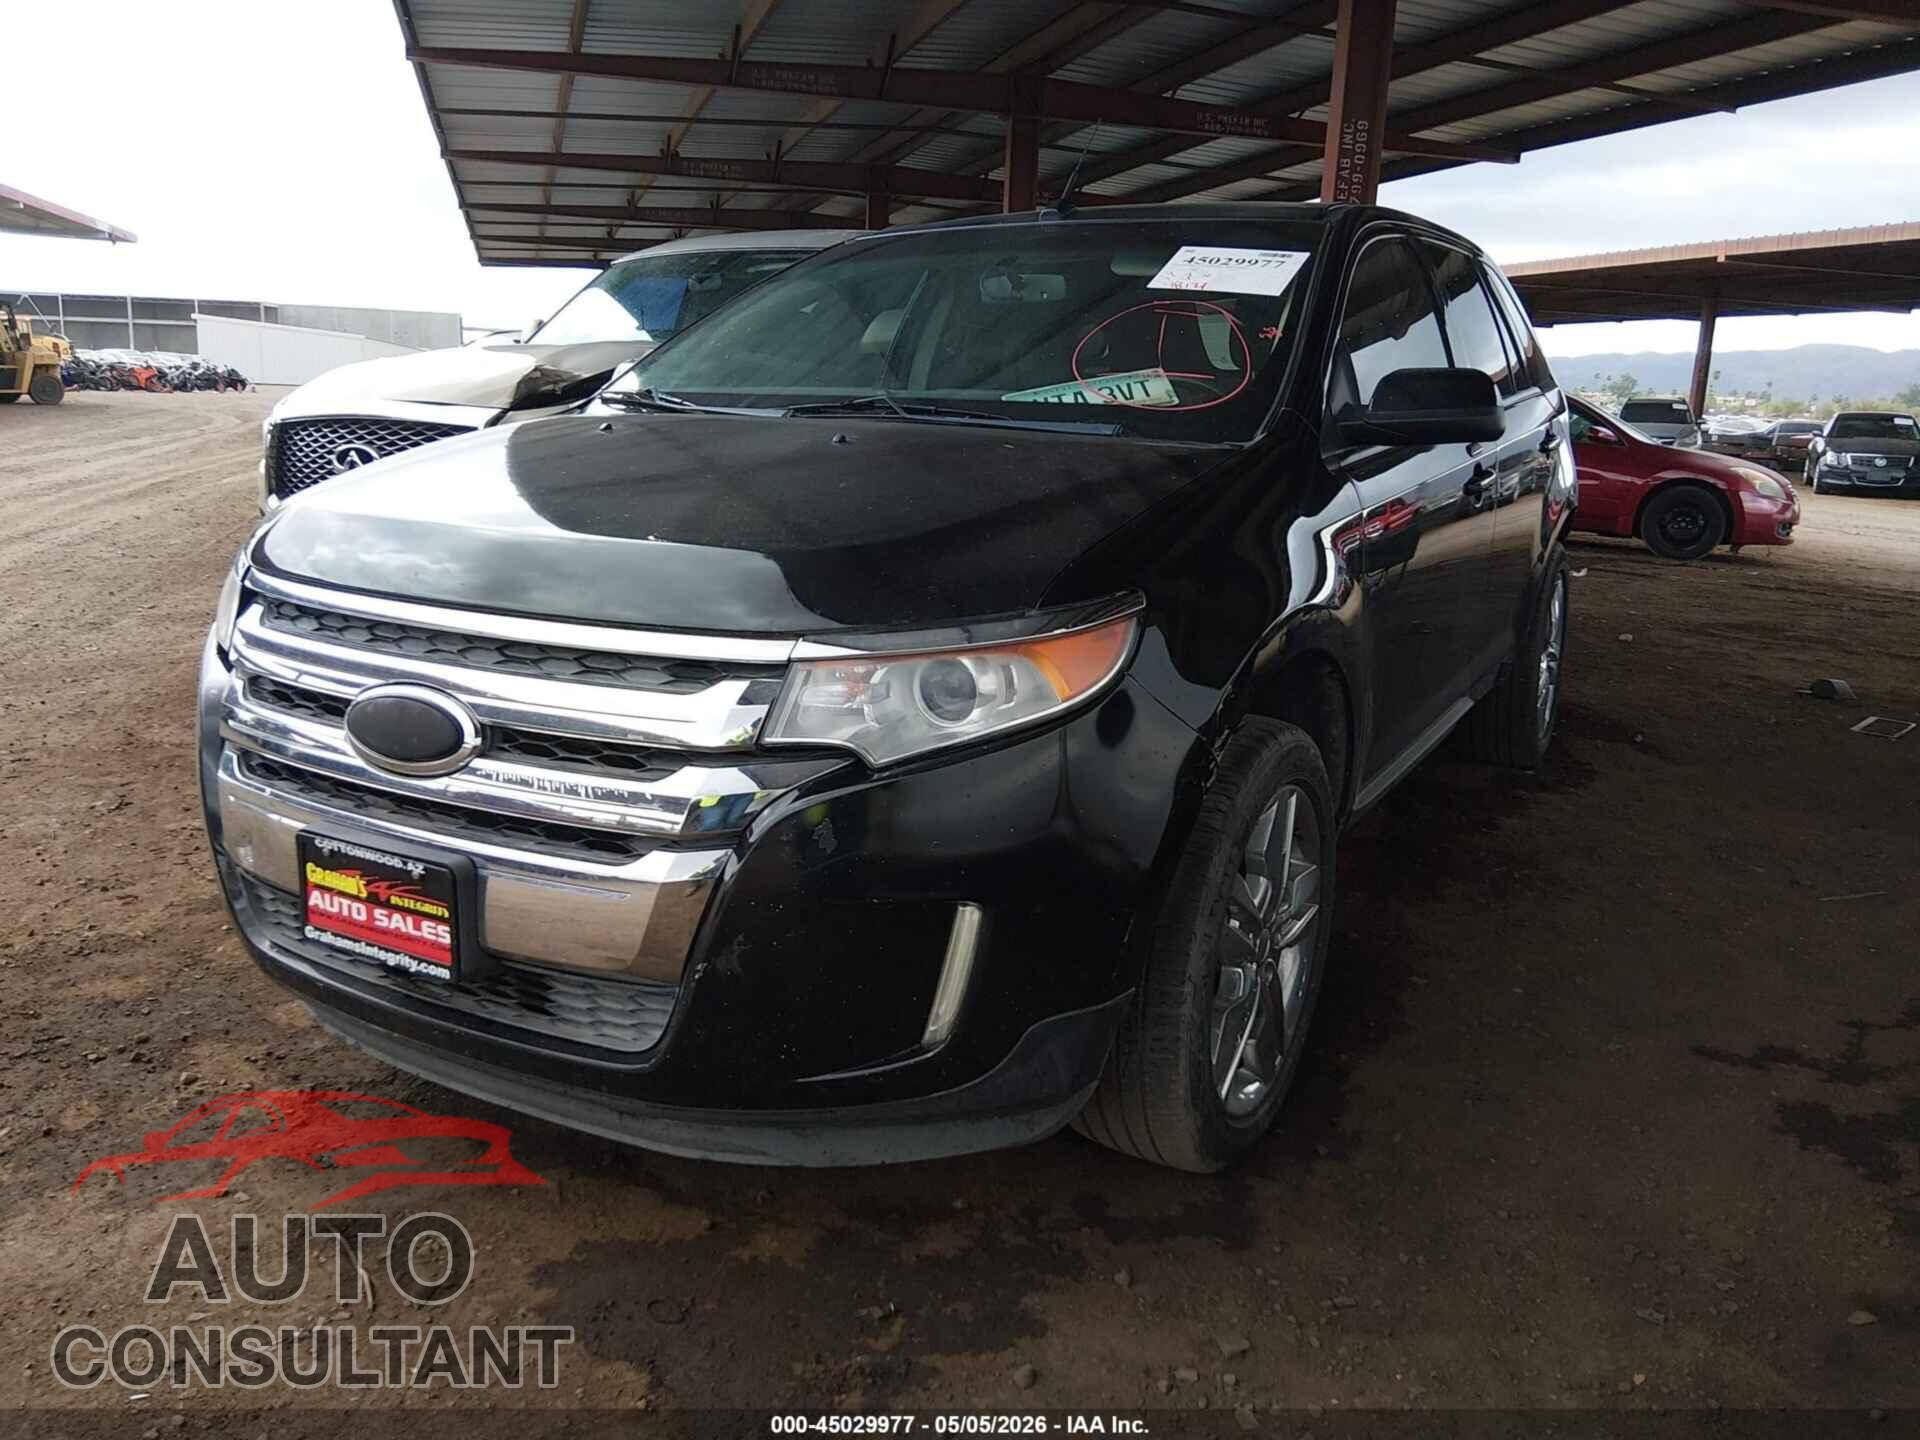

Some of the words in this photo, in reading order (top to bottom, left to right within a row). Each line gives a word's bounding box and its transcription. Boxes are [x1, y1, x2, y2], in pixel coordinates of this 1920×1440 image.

[1341, 118, 1355, 149] INC.
[1183, 255, 1287, 269] 45029977
[308, 890, 367, 921] AUTO
[374, 908, 451, 944] SALES
[390, 895, 450, 918] INTEGRITY
